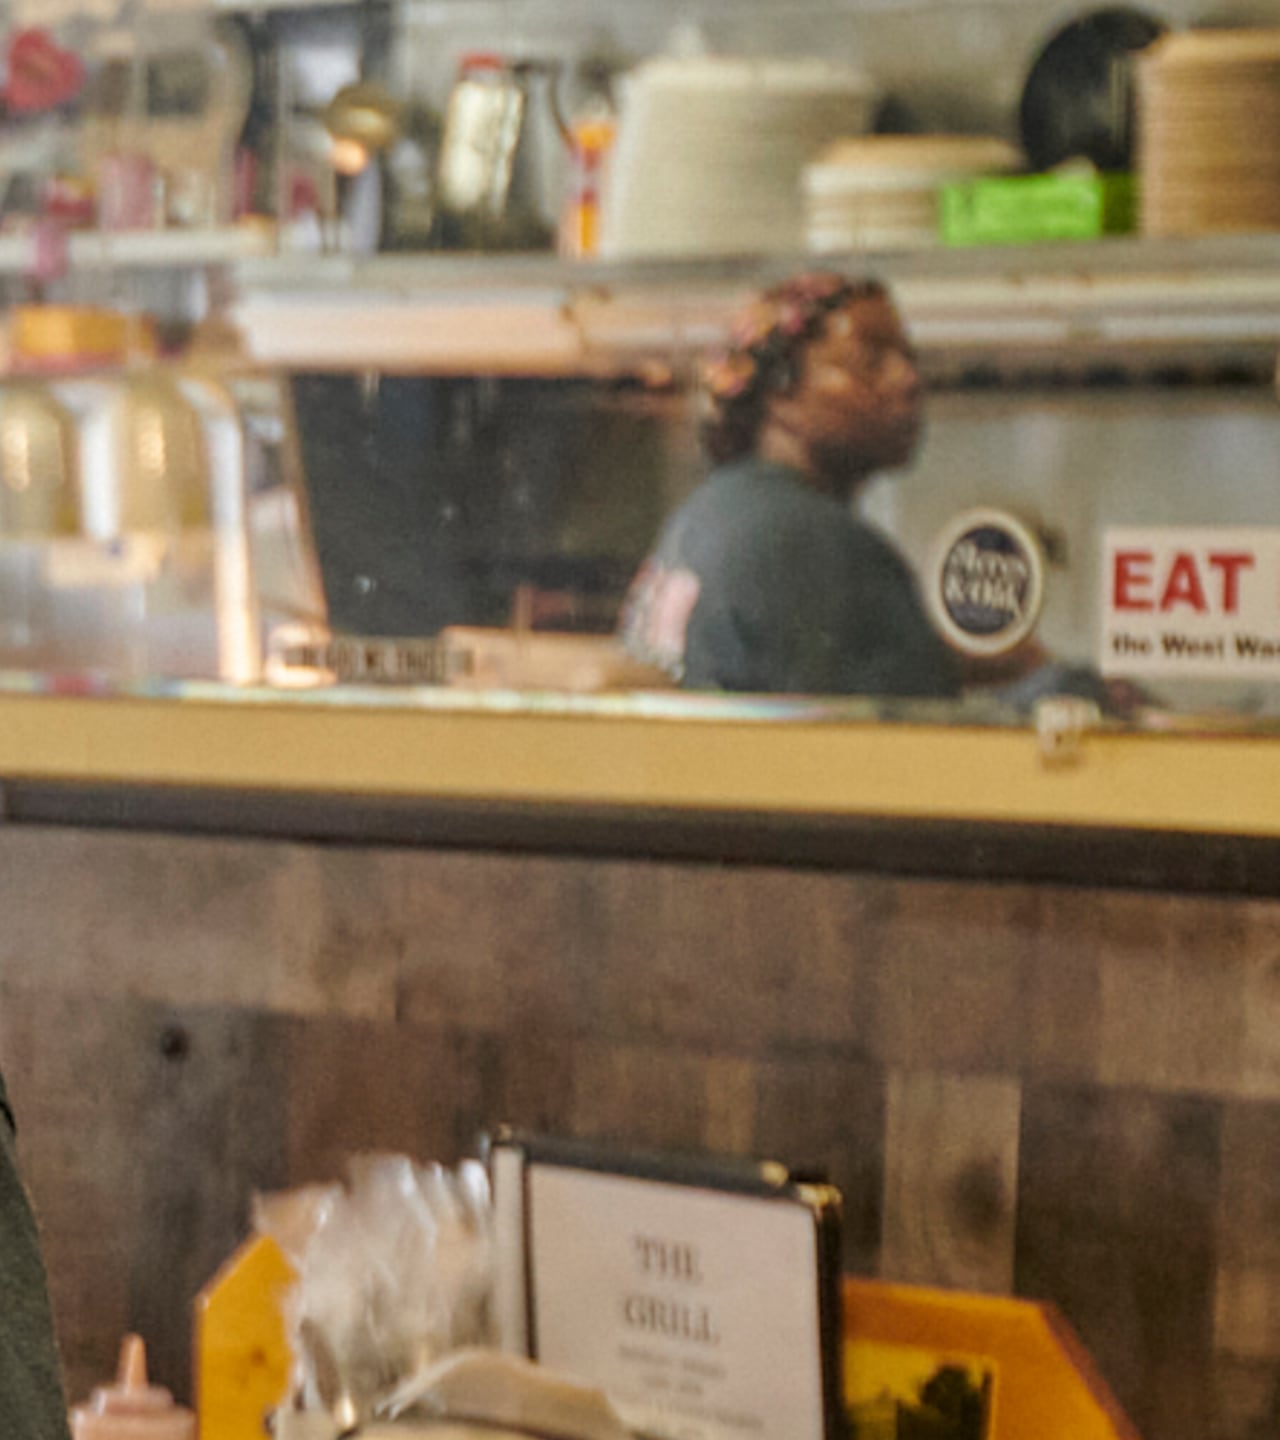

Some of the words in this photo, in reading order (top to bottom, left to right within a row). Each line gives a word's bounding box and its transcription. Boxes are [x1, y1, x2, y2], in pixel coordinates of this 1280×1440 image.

[1112, 549, 1258, 615] EAT
[635, 1234, 702, 1283] THE
[624, 1295, 720, 1345] GRILL
